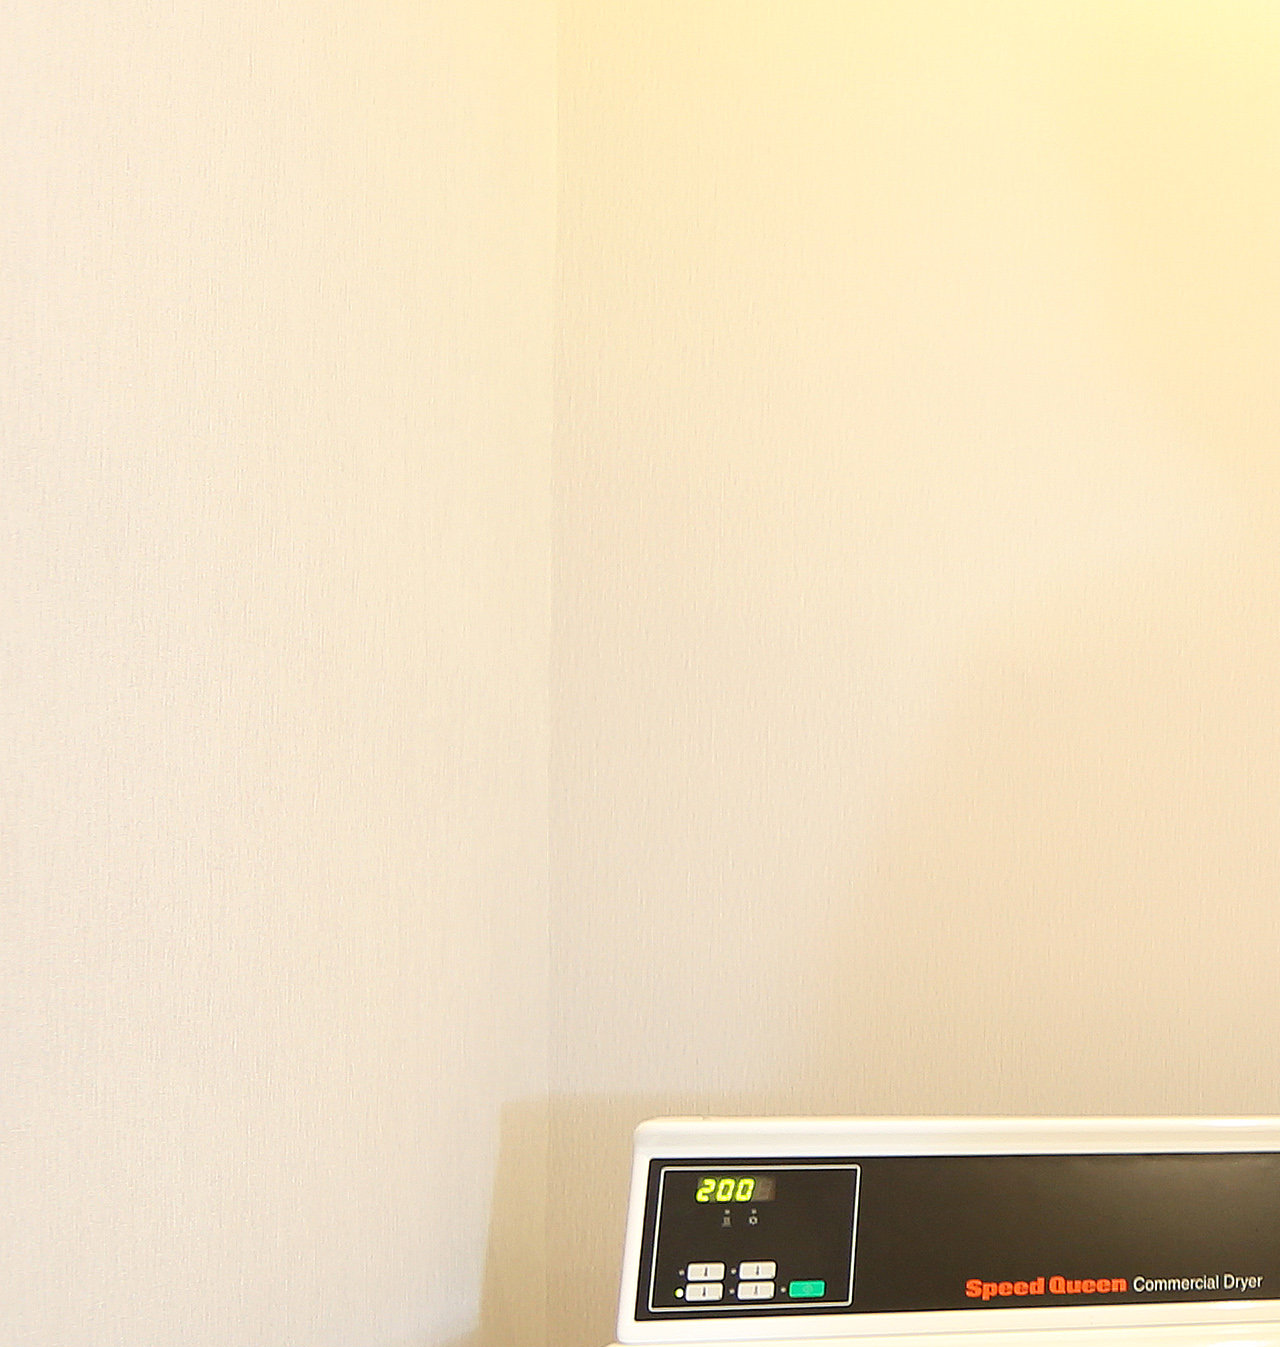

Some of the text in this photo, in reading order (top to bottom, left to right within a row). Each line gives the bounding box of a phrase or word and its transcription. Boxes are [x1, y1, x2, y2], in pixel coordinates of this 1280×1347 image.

[695, 1177, 756, 1203] 200
[965, 1273, 1264, 1301] Speed Queen Commercial Dryer
